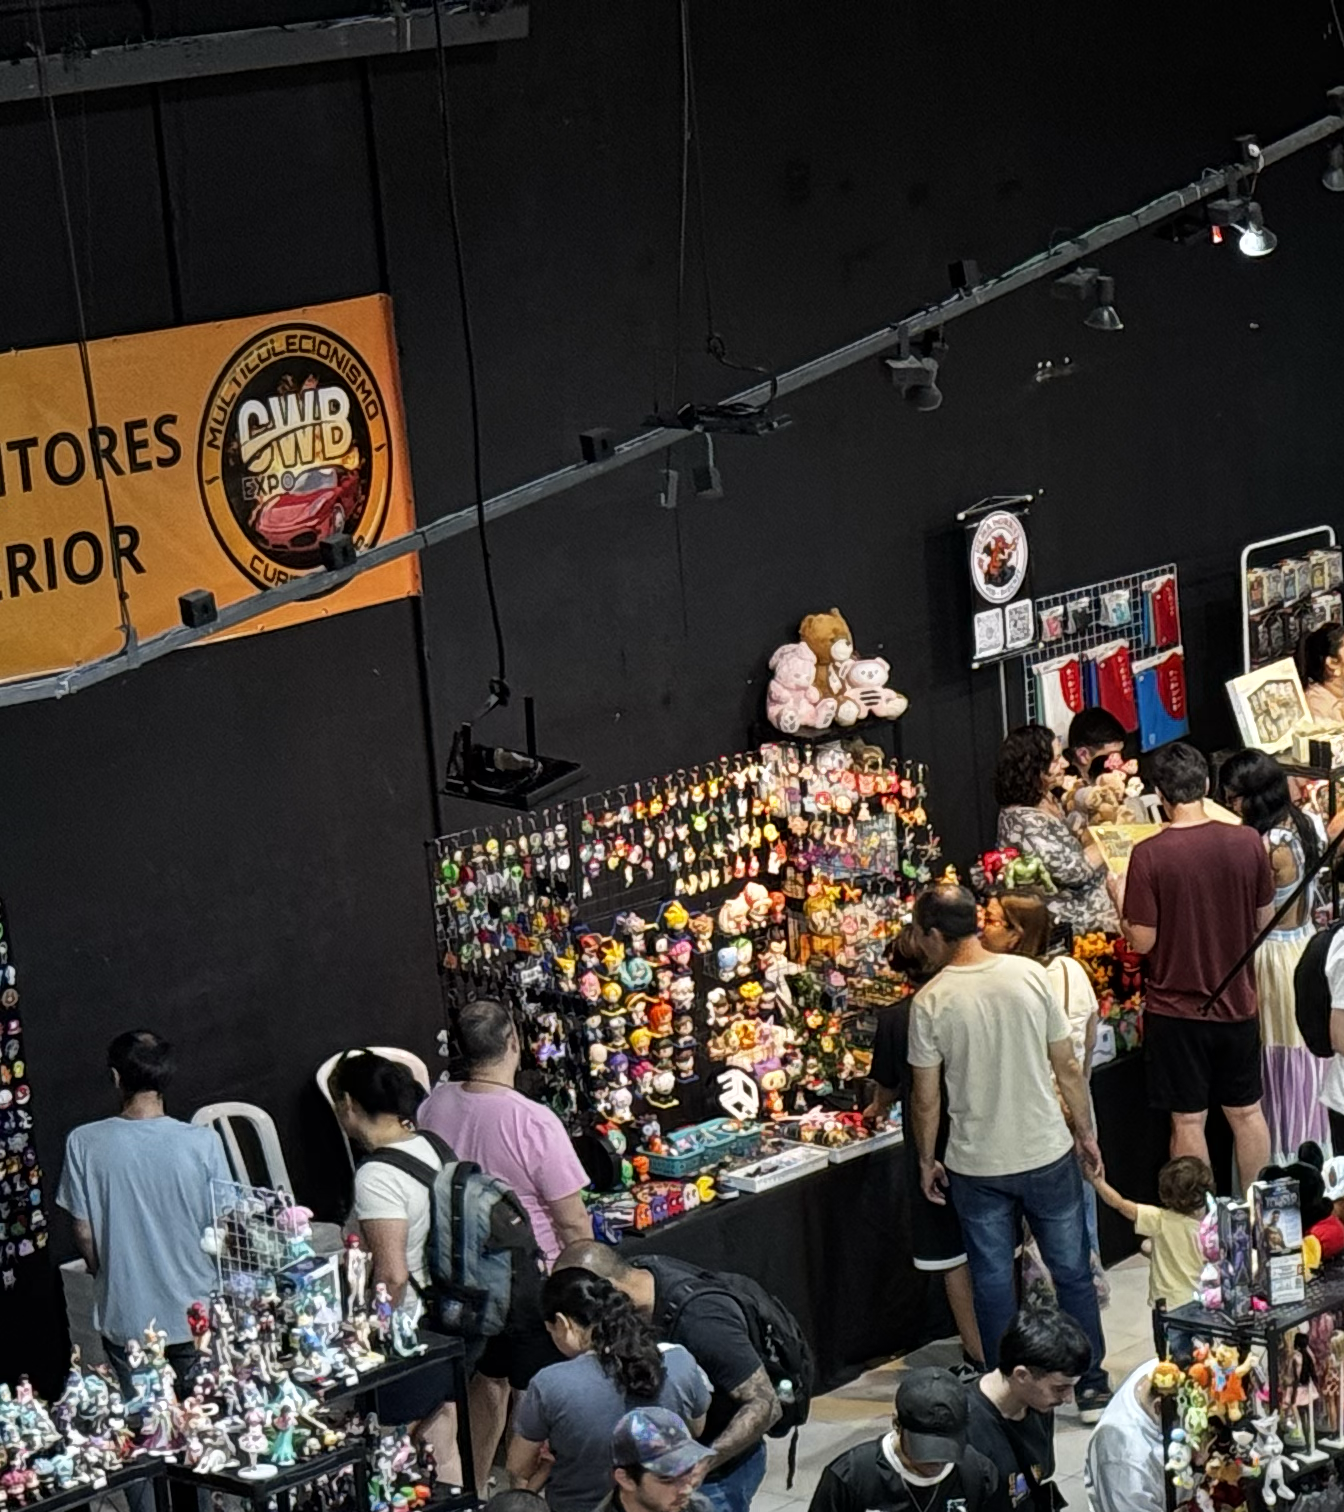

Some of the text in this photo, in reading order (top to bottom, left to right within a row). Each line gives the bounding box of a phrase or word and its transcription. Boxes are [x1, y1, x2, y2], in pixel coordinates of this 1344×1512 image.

[206, 333, 380, 451] MULTICOLECIONISMO
[237, 385, 353, 474] CWB
[0, 524, 146, 599] RIOR
